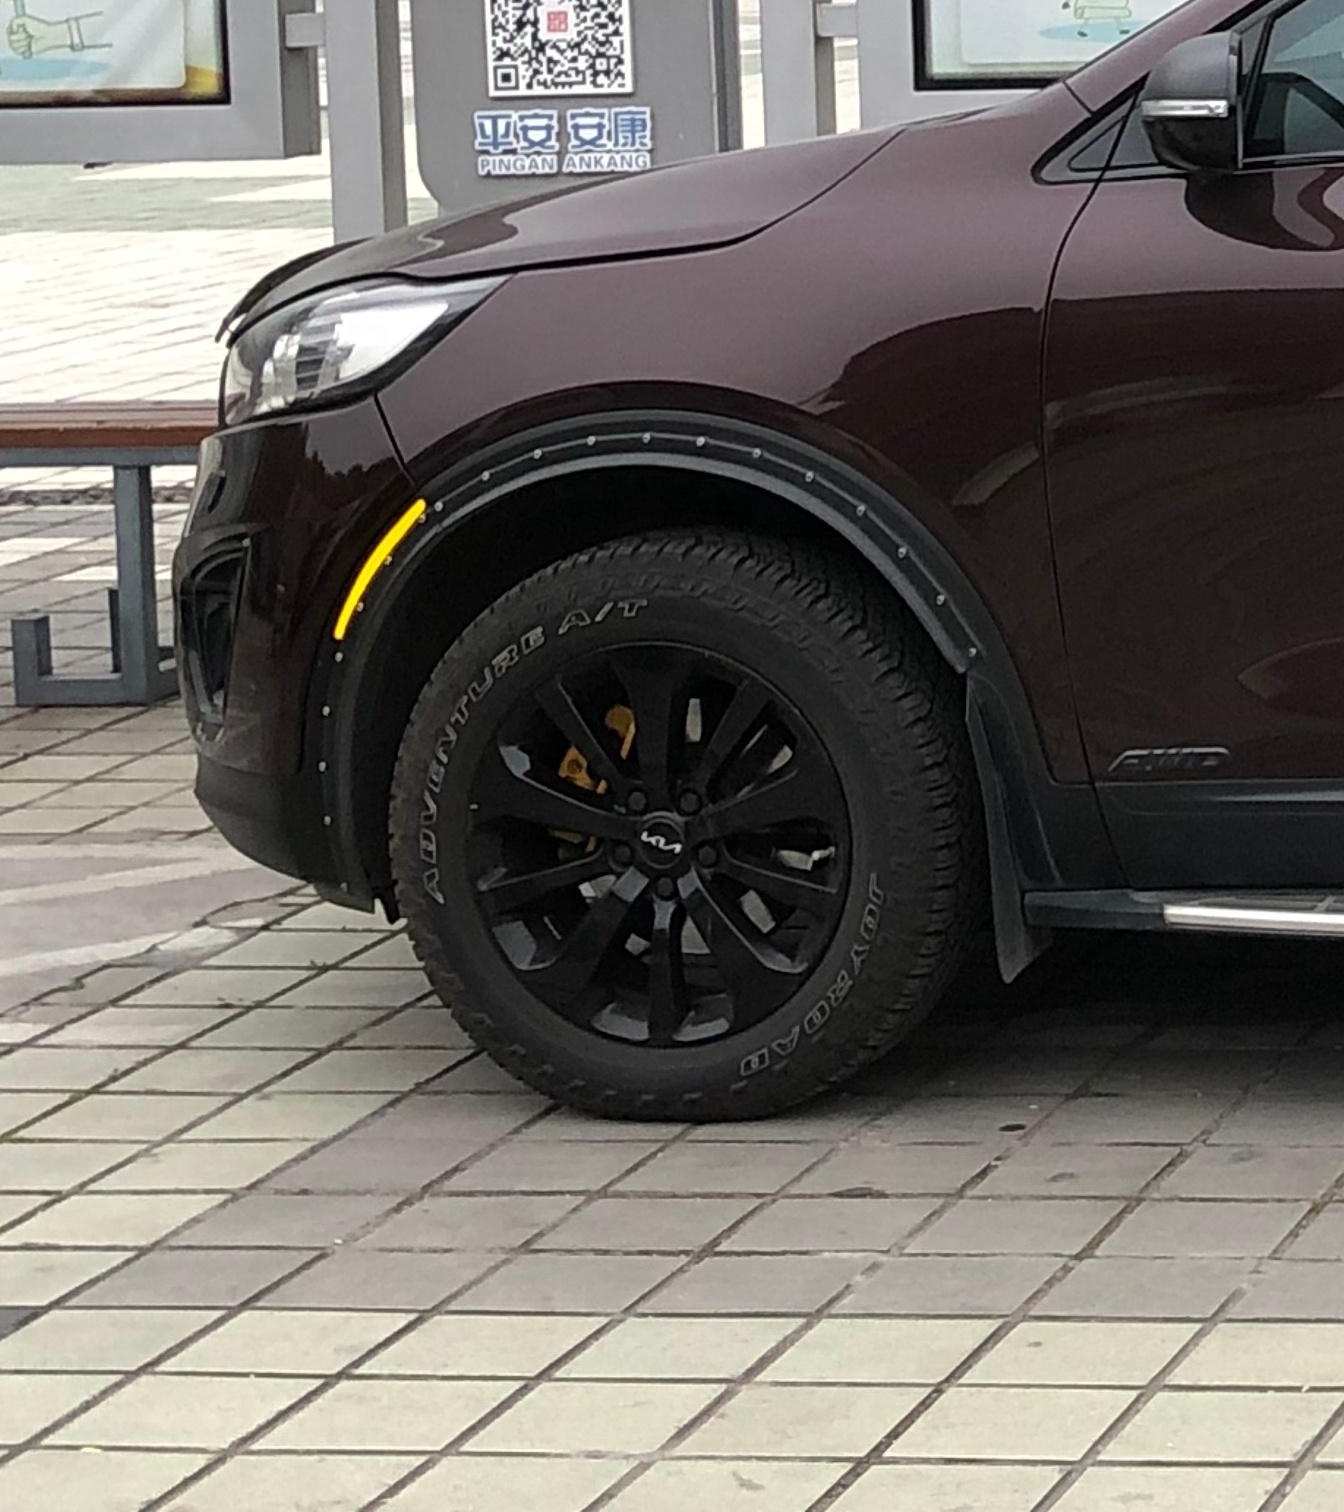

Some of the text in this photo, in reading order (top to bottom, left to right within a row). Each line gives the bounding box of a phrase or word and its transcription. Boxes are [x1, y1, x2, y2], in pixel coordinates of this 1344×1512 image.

[478, 151, 650, 176] PINGAN ANKANG
[418, 598, 648, 906] ADVENTURE A/T
[740, 872, 887, 1078] JOYROAD
